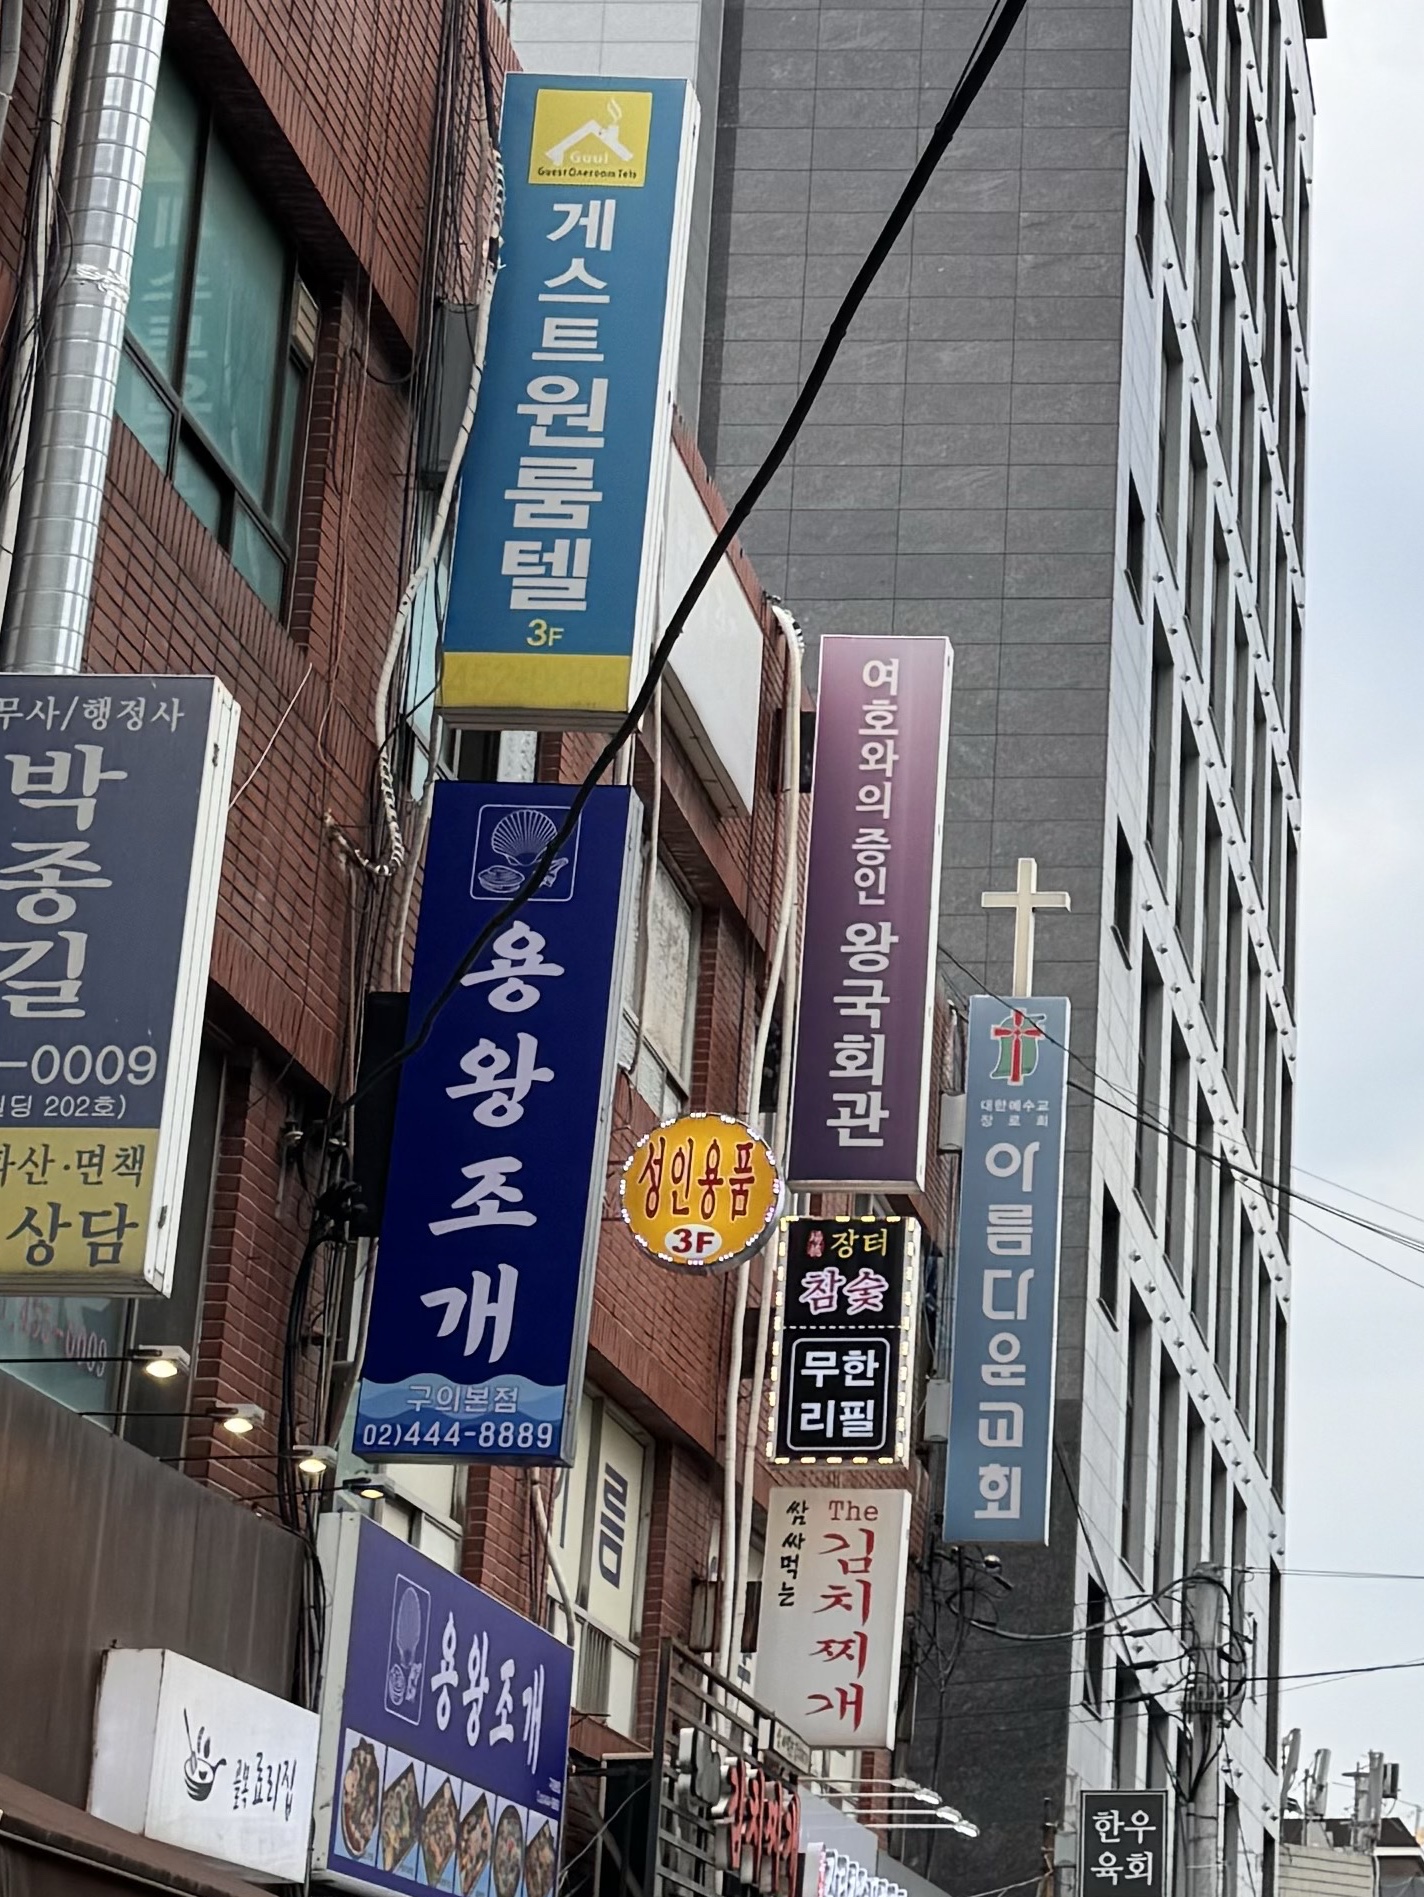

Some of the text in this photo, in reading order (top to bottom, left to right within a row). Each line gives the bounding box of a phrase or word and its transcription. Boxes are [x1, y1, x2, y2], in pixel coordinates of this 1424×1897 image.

[501, 198, 616, 612] 게스트원룸텔
[526, 618, 565, 648] 3F
[0, 743, 127, 1019] 박종길
[826, 921, 899, 1147] 왕국회관
[43, 1093, 127, 1120] 202호)
[420, 919, 565, 1364] 용왕조개
[637, 1136, 756, 1221] 성인용품
[6, 1203, 138, 1267] 상담
[671, 1226, 715, 1256] 3F
[830, 1229, 888, 1258] 장터
[800, 1267, 889, 1315] 참숯
[973, 1140, 1041, 1521] 아름다운교회
[800, 1349, 879, 1388] 무한
[407, 1385, 520, 1414] 구의본점
[362, 1420, 553, 1449] 02)444-8889
[800, 1401, 875, 1439] 리필
[828, 1500, 878, 1522] The
[805, 1528, 875, 1732] 김치찌개
[430, 1610, 544, 1776] 용왕조개
[1092, 1810, 1157, 1845] 한우
[1090, 1851, 1154, 1886] 육회
